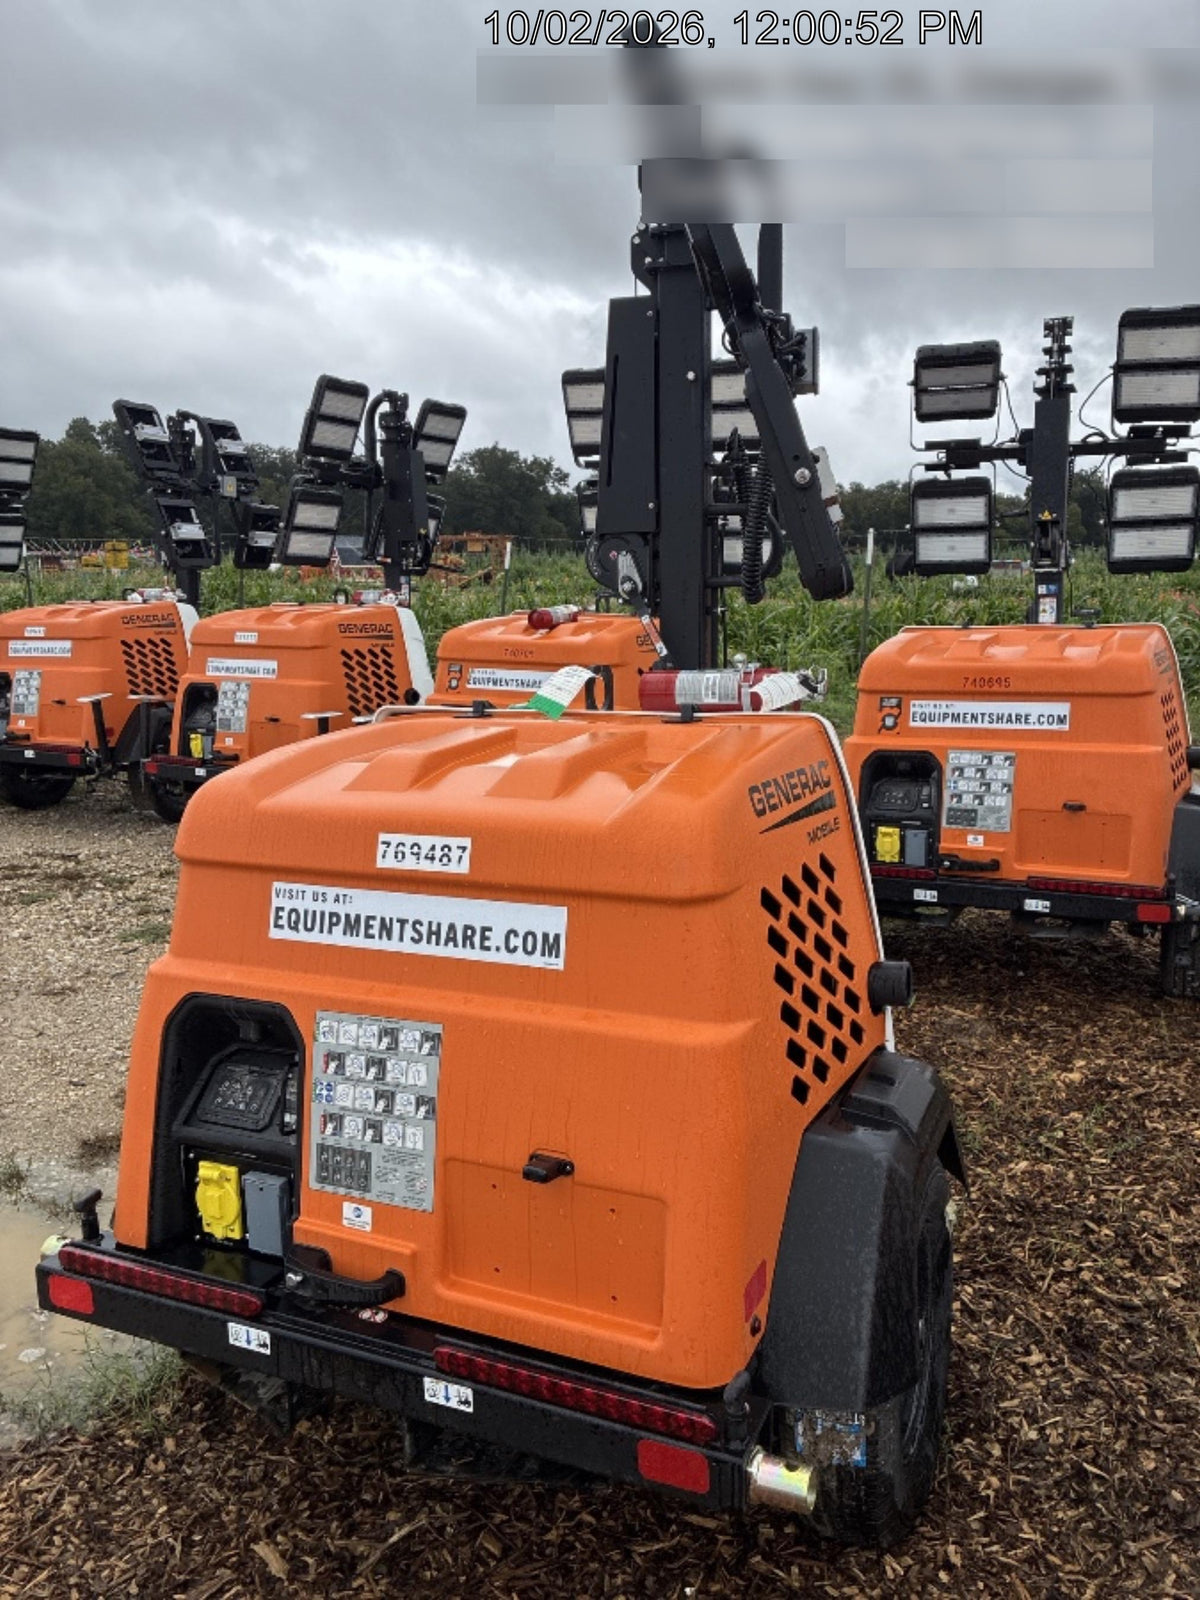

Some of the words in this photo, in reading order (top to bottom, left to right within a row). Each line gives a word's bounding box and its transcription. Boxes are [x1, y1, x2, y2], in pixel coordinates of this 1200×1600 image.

[338, 623, 394, 634] GENERAC
[962, 677, 1011, 689] 740695
[911, 711, 1068, 726] EQUIPMENTSHARE.COM
[747, 760, 831, 818] GENERAC
[806, 816, 840, 845] MOBILE
[379, 840, 468, 867] 769487
[274, 887, 306, 901] VISIT
[312, 890, 328, 903] US
[333, 893, 353, 904] AT:
[273, 906, 561, 959] EQUIPMENTSHARE.COM
